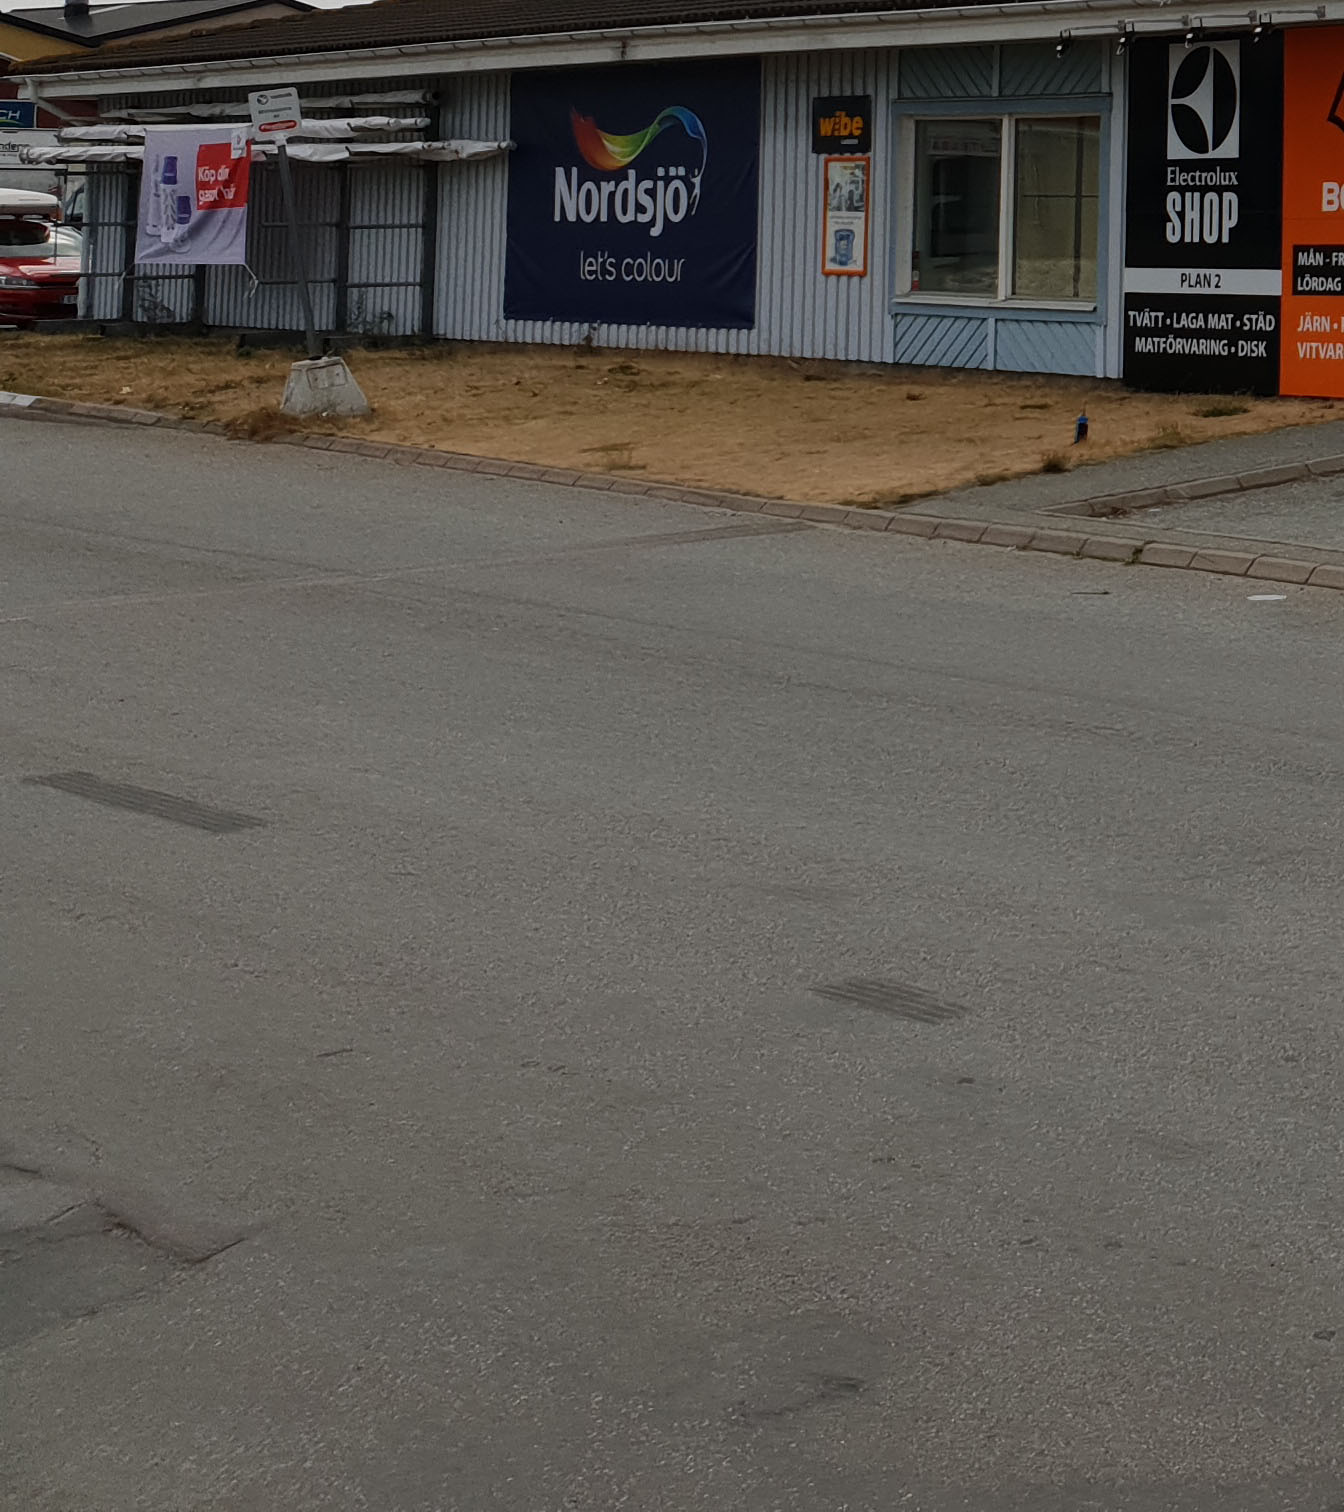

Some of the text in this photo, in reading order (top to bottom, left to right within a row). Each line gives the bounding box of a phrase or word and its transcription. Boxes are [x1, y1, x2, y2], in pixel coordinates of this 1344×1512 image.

[819, 111, 863, 137] wibe
[1166, 166, 1239, 186] Electrolux
[554, 166, 688, 237] Nordsjö
[1166, 191, 1239, 244] SHOP
[580, 251, 685, 282] let's colour
[1298, 248, 1323, 266] MÅN
[1180, 273, 1221, 288] PLAN 2
[1297, 274, 1342, 292] LÖRDAG
[1128, 308, 1276, 331] TVÄTT LAGA MAT STÄD
[1297, 312, 1331, 332] JÄRN
[1135, 334, 1267, 357] MATFÖRVARING DISK
